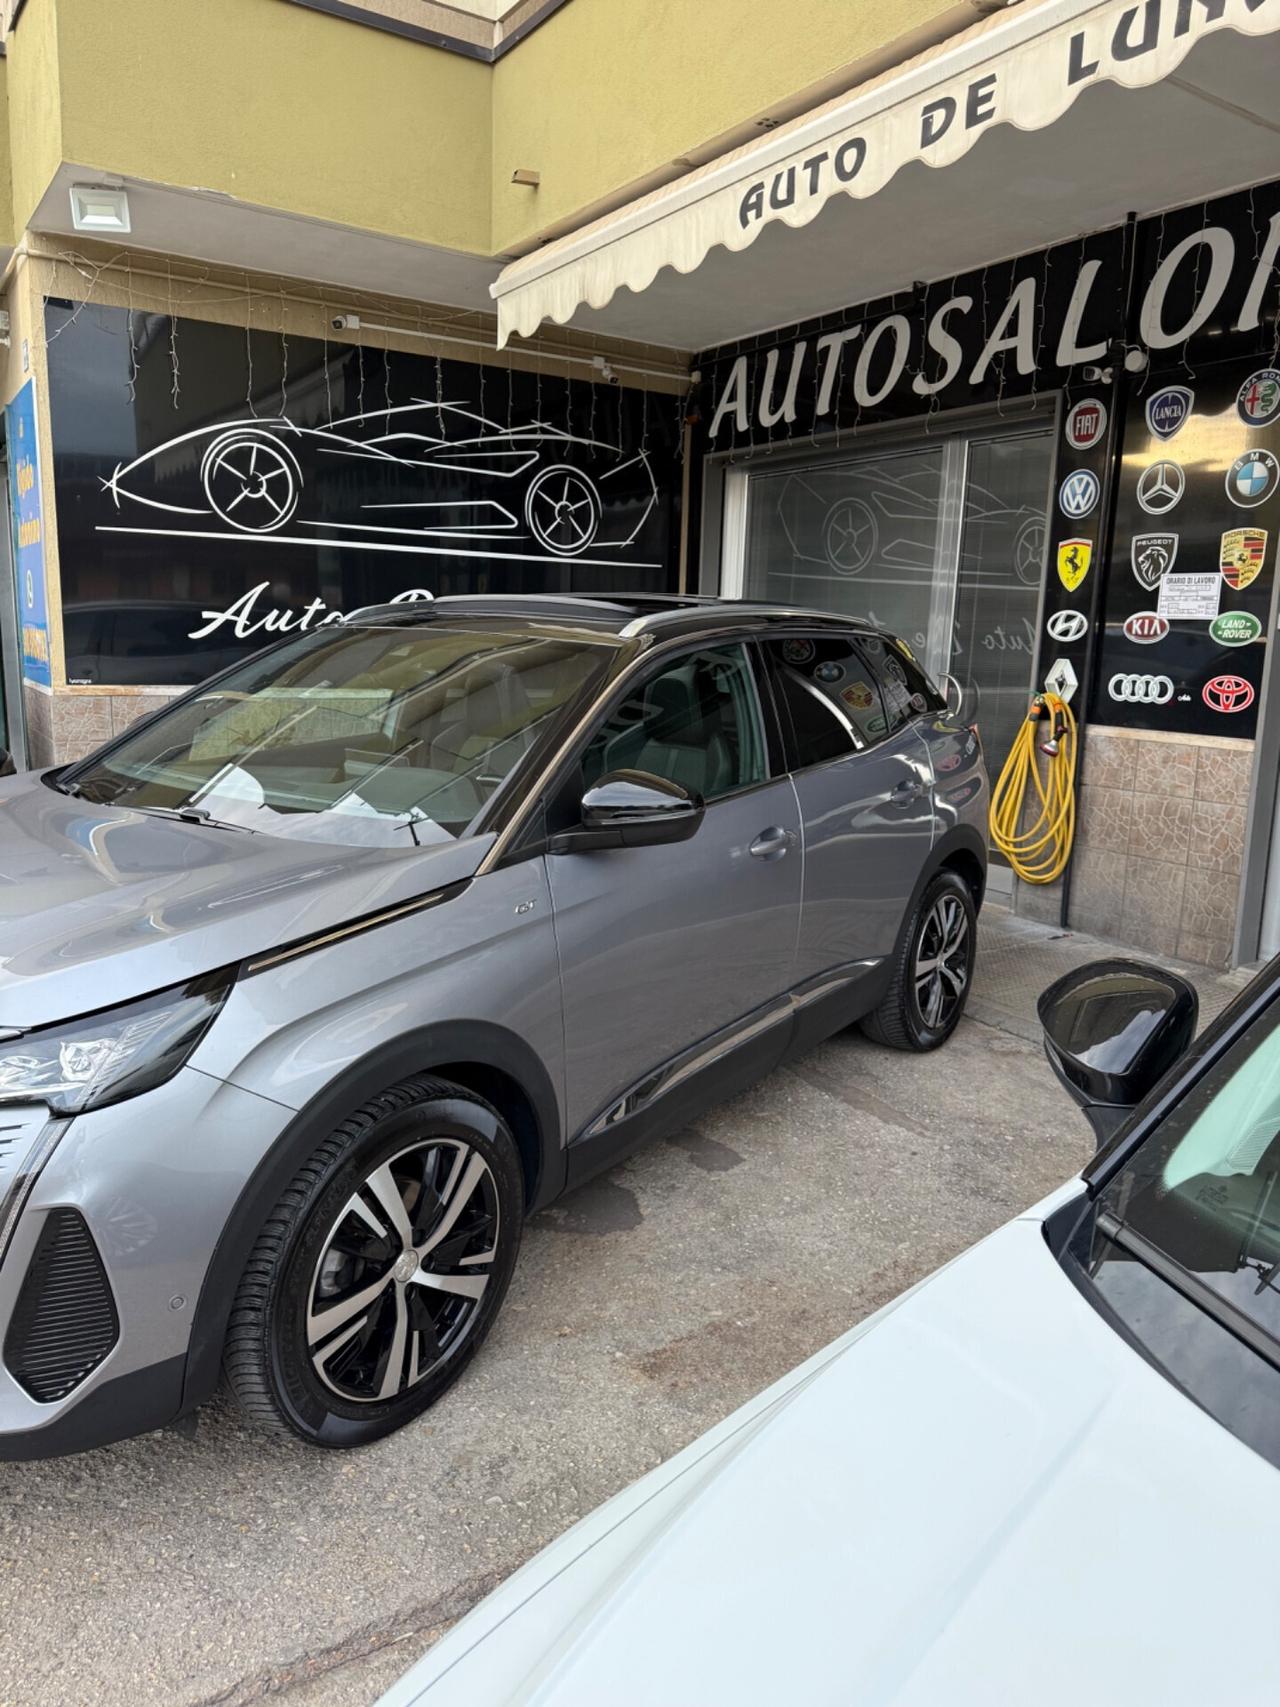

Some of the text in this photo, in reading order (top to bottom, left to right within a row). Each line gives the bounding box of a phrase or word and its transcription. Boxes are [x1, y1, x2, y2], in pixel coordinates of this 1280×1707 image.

[738, 0, 1267, 229] AUTO DE LUN
[1155, 404, 1182, 420] LANCIA
[1075, 414, 1099, 437] FIAT
[1234, 451, 1275, 471] BMW
[1136, 538, 1173, 546] PEUGEOT
[1166, 576, 1216, 586] ORARIO DI LAVORO
[187, 580, 344, 640] Auto
[1131, 617, 1162, 636] KIA
